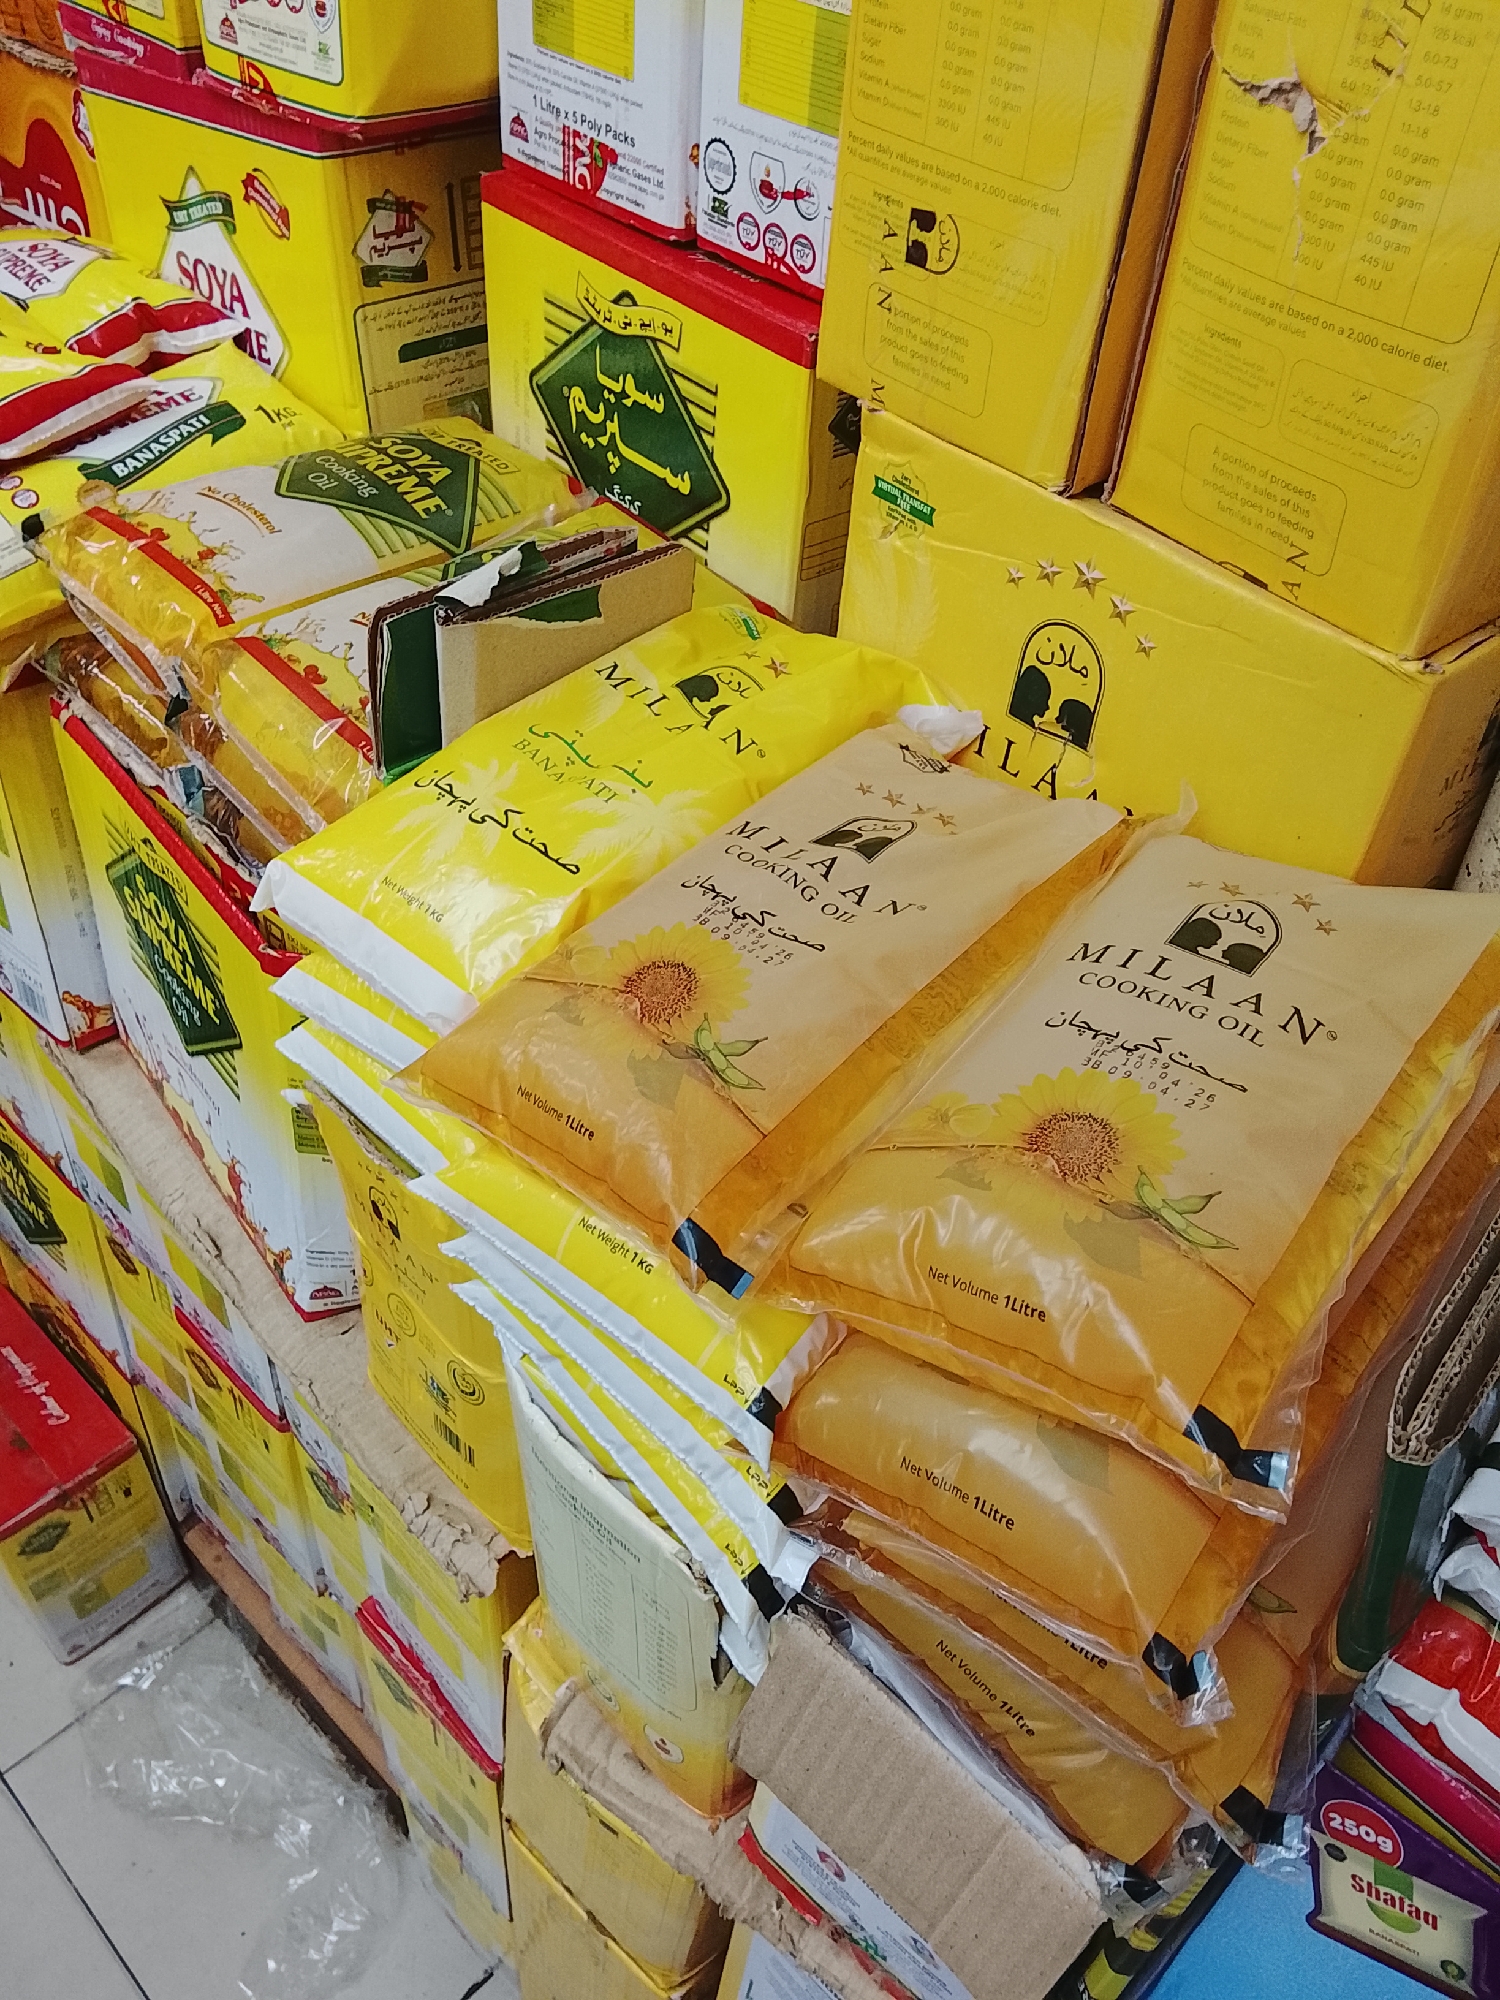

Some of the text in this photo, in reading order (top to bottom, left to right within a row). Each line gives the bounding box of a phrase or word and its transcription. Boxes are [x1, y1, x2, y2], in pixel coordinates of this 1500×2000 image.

[1455, 8, 1484, 22] gram
[532, 94, 636, 148] 1 Litre x 5 Poly Packs
[848, 130, 1062, 218] Percent daily values based 2,000 calorie diet.
[1404, 174, 1432, 190] gram
[1411, 151, 1440, 167] gram
[1390, 218, 1418, 233] gram
[1398, 196, 1424, 212] gram
[18, 242, 75, 273] SOYA
[1360, 254, 1394, 272] 445 IU
[1384, 240, 1410, 254] gram
[175, 250, 251, 320] SOYA
[1354, 274, 1382, 290] 40 IU
[1182, 257, 1450, 374] Percent daily values are based on a 2,000 calorie diet.
[1228, 300, 1242, 312] are
[1242, 308, 1276, 327] average
[1278, 321, 1306, 339] values
[596, 342, 666, 414] سویا
[111, 414, 212, 478] BANASPATI
[368, 437, 452, 486] SOYA
[568, 385, 692, 496] سپریم
[306, 472, 339, 491] Oil
[316, 455, 379, 498] Cooking
[878, 480, 932, 516] VIRTUAL TRANSFAT
[1212, 446, 1318, 502] A portion of proceeds
[1212, 462, 1310, 519] from the sales of this
[202, 484, 282, 535] No Cholesterol
[1202, 478, 1315, 540] product goes to feeding
[1217, 500, 1290, 545] families in need
[415, 770, 581, 875] صحت کی پہچان
[381, 876, 398, 891] Net
[396, 885, 424, 910] Weight
[724, 820, 916, 916] MILAAN
[724, 844, 860, 924] COOKING OIL
[135, 874, 195, 968] SOYA
[732, 906, 778, 928] کی
[768, 926, 826, 953] صحت
[124, 886, 220, 1026] SUPREME
[154, 954, 202, 1028] Cooking
[172, 998, 190, 1028] Oil
[1066, 942, 1326, 1046] MILAAN
[1078, 972, 1265, 1048] COOKING OIL
[1044, 1010, 1248, 1093] صحت کی پہچان
[517, 1084, 595, 1142] Net Volume 1Litre
[578, 1216, 596, 1236] Net
[596, 1228, 630, 1258] Weight
[928, 1264, 1047, 1324] Net Volume 1Litre
[900, 1456, 1016, 1531] Net Volume 1Litre
[936, 1638, 1036, 1740] Net Volume 1Litre
[1328, 1810, 1394, 1856] 250g
